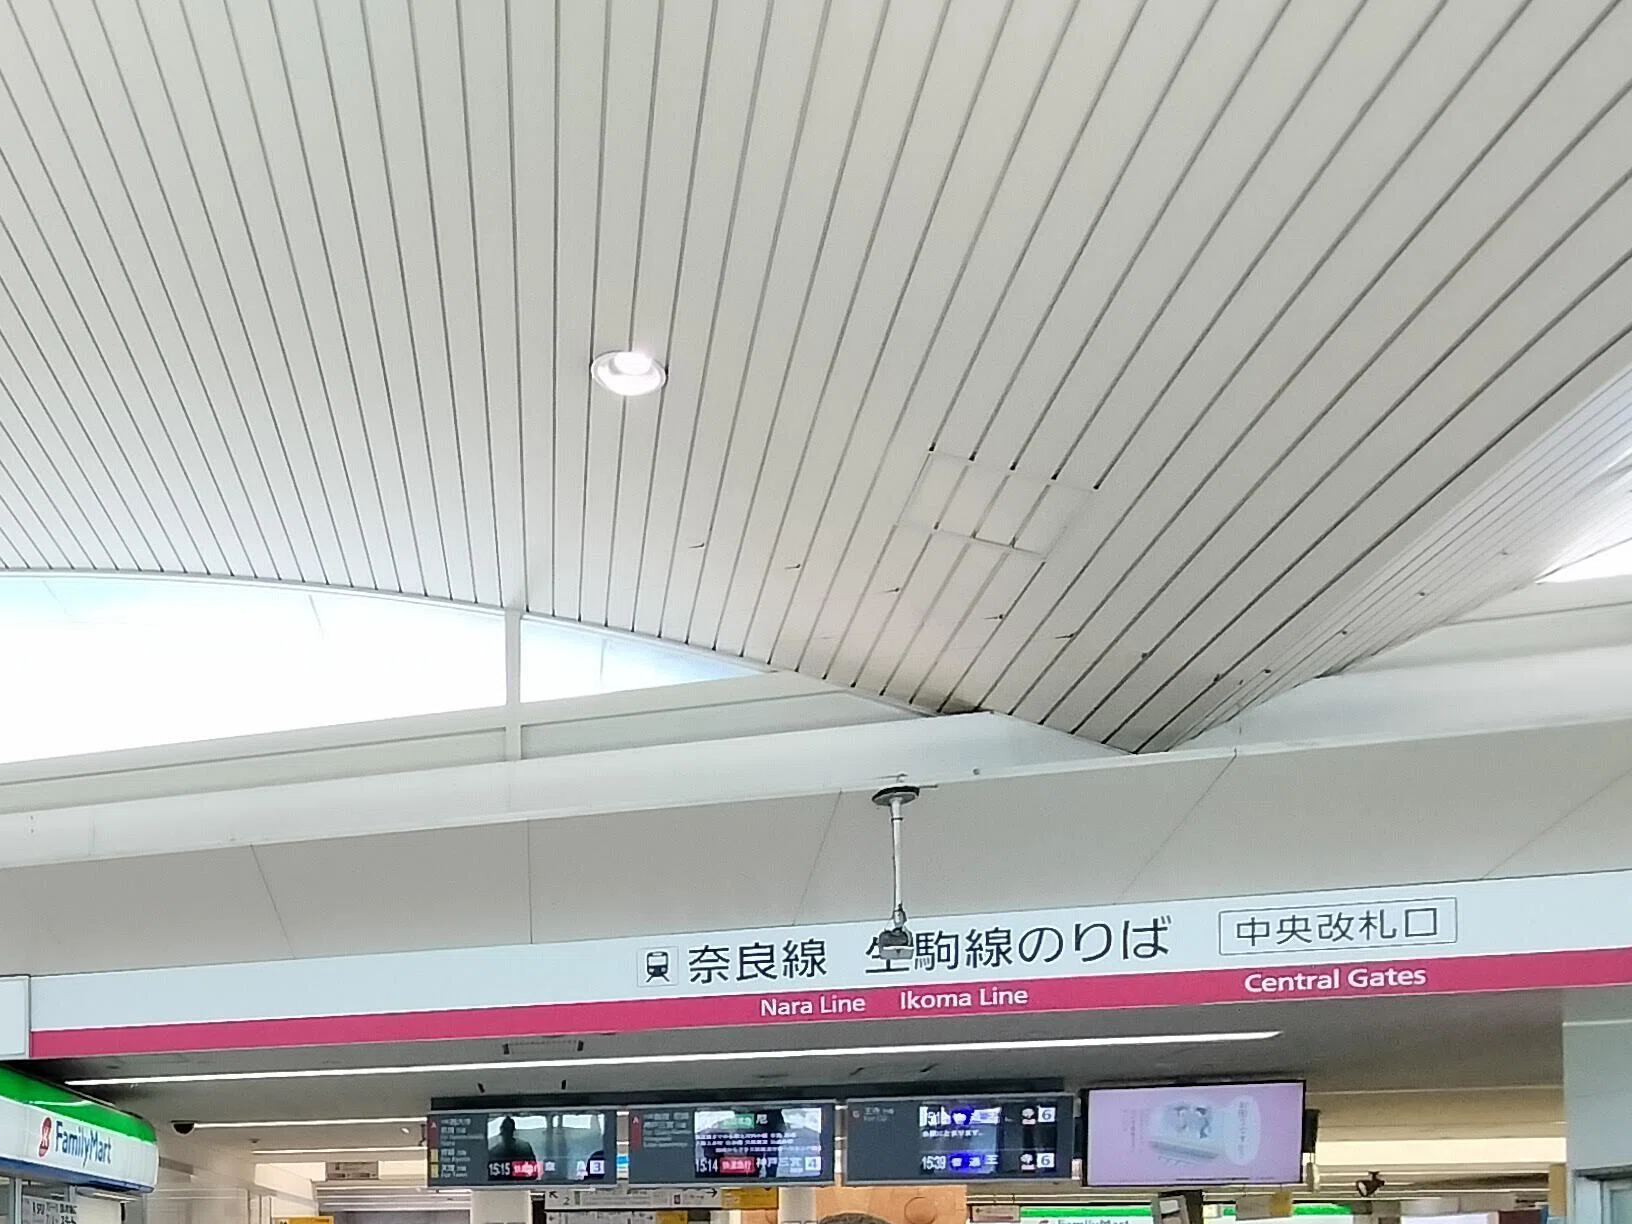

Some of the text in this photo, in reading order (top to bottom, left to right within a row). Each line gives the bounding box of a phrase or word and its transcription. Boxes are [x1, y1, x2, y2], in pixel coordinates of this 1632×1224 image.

[1236, 908, 1438, 947] 中央改札口
[688, 938, 828, 983] 奈良線
[1244, 966, 1427, 993] Central Gates
[760, 987, 1028, 1016] Nara Line Ikoma Line
[55, 1120, 112, 1168] FamilyMart
